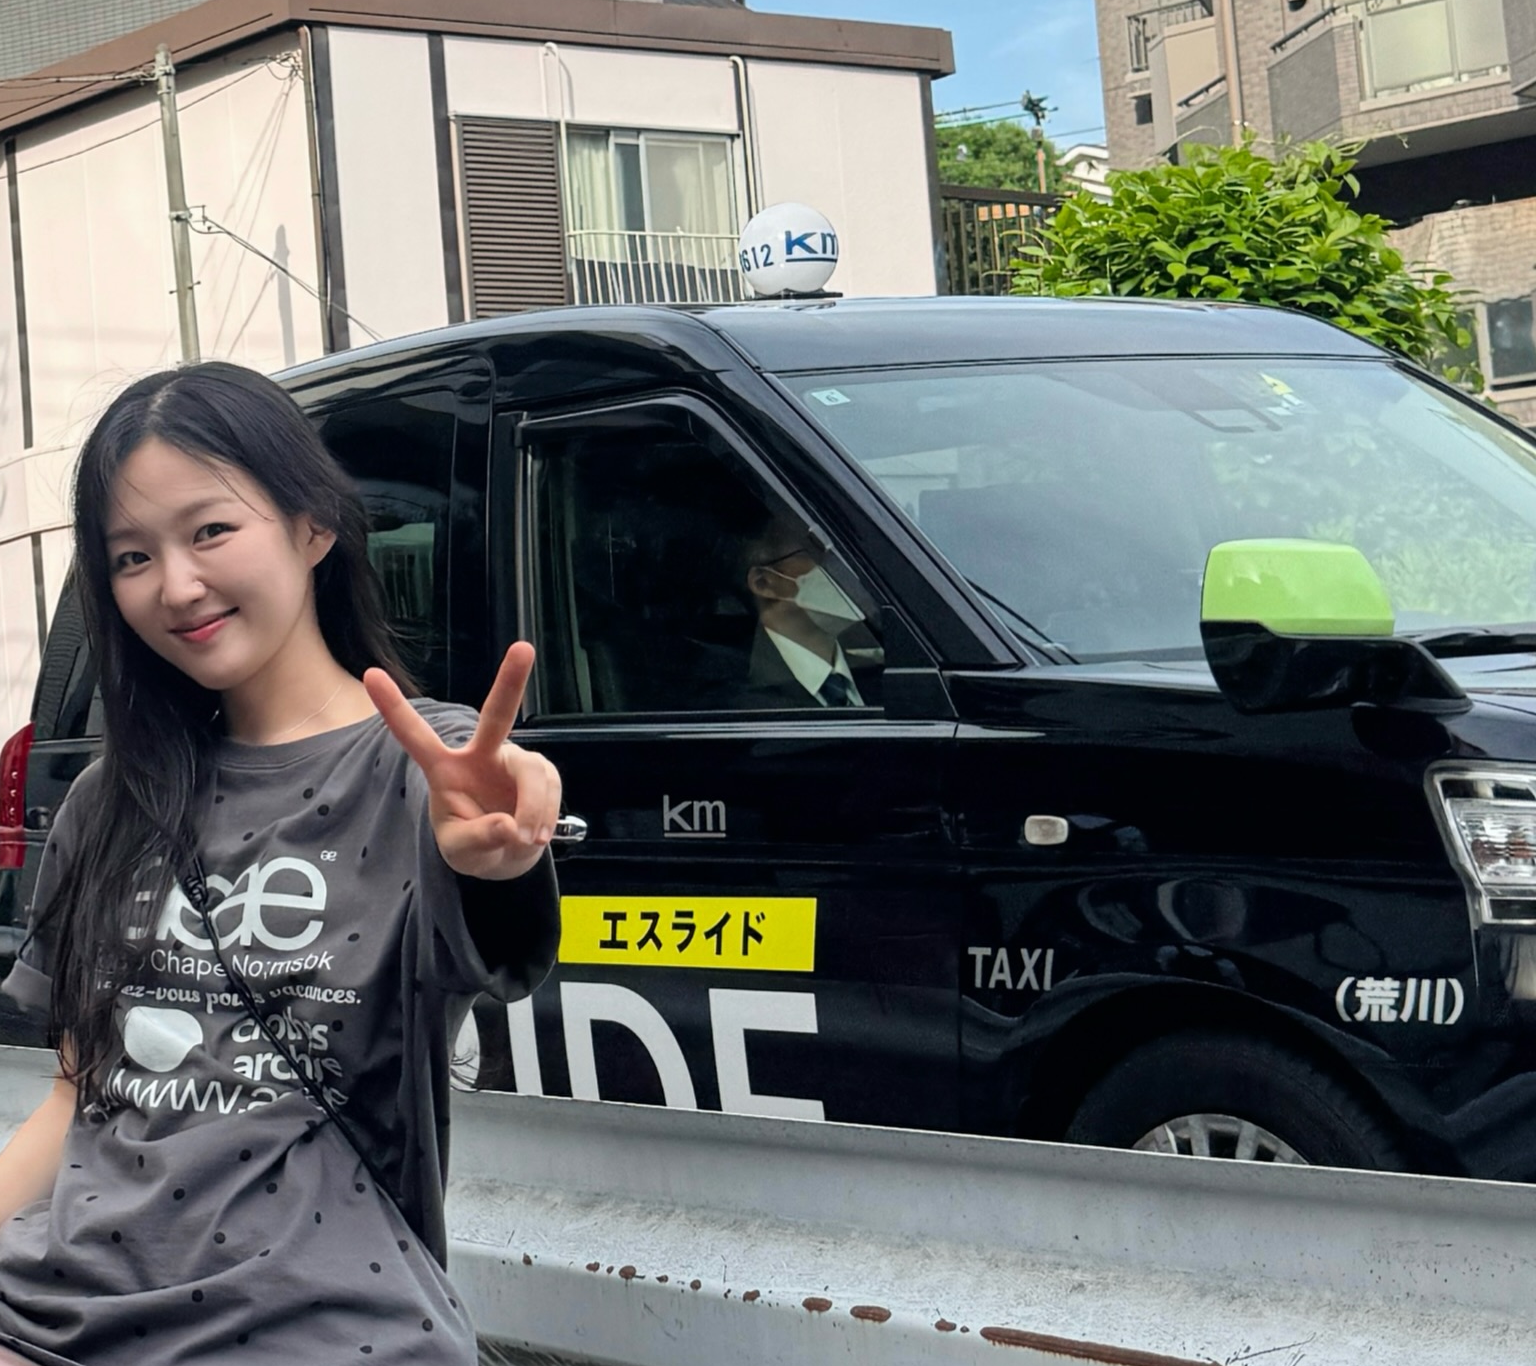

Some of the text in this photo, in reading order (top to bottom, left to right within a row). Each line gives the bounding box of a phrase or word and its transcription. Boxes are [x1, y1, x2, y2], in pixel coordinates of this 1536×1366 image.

[739, 244, 774, 274] 612
[663, 794, 726, 838] km
[599, 910, 767, 956] エスライド
[967, 946, 1055, 991] TAXI
[1335, 976, 1464, 1025] (荒川)
[451, 981, 826, 1122] IDE
